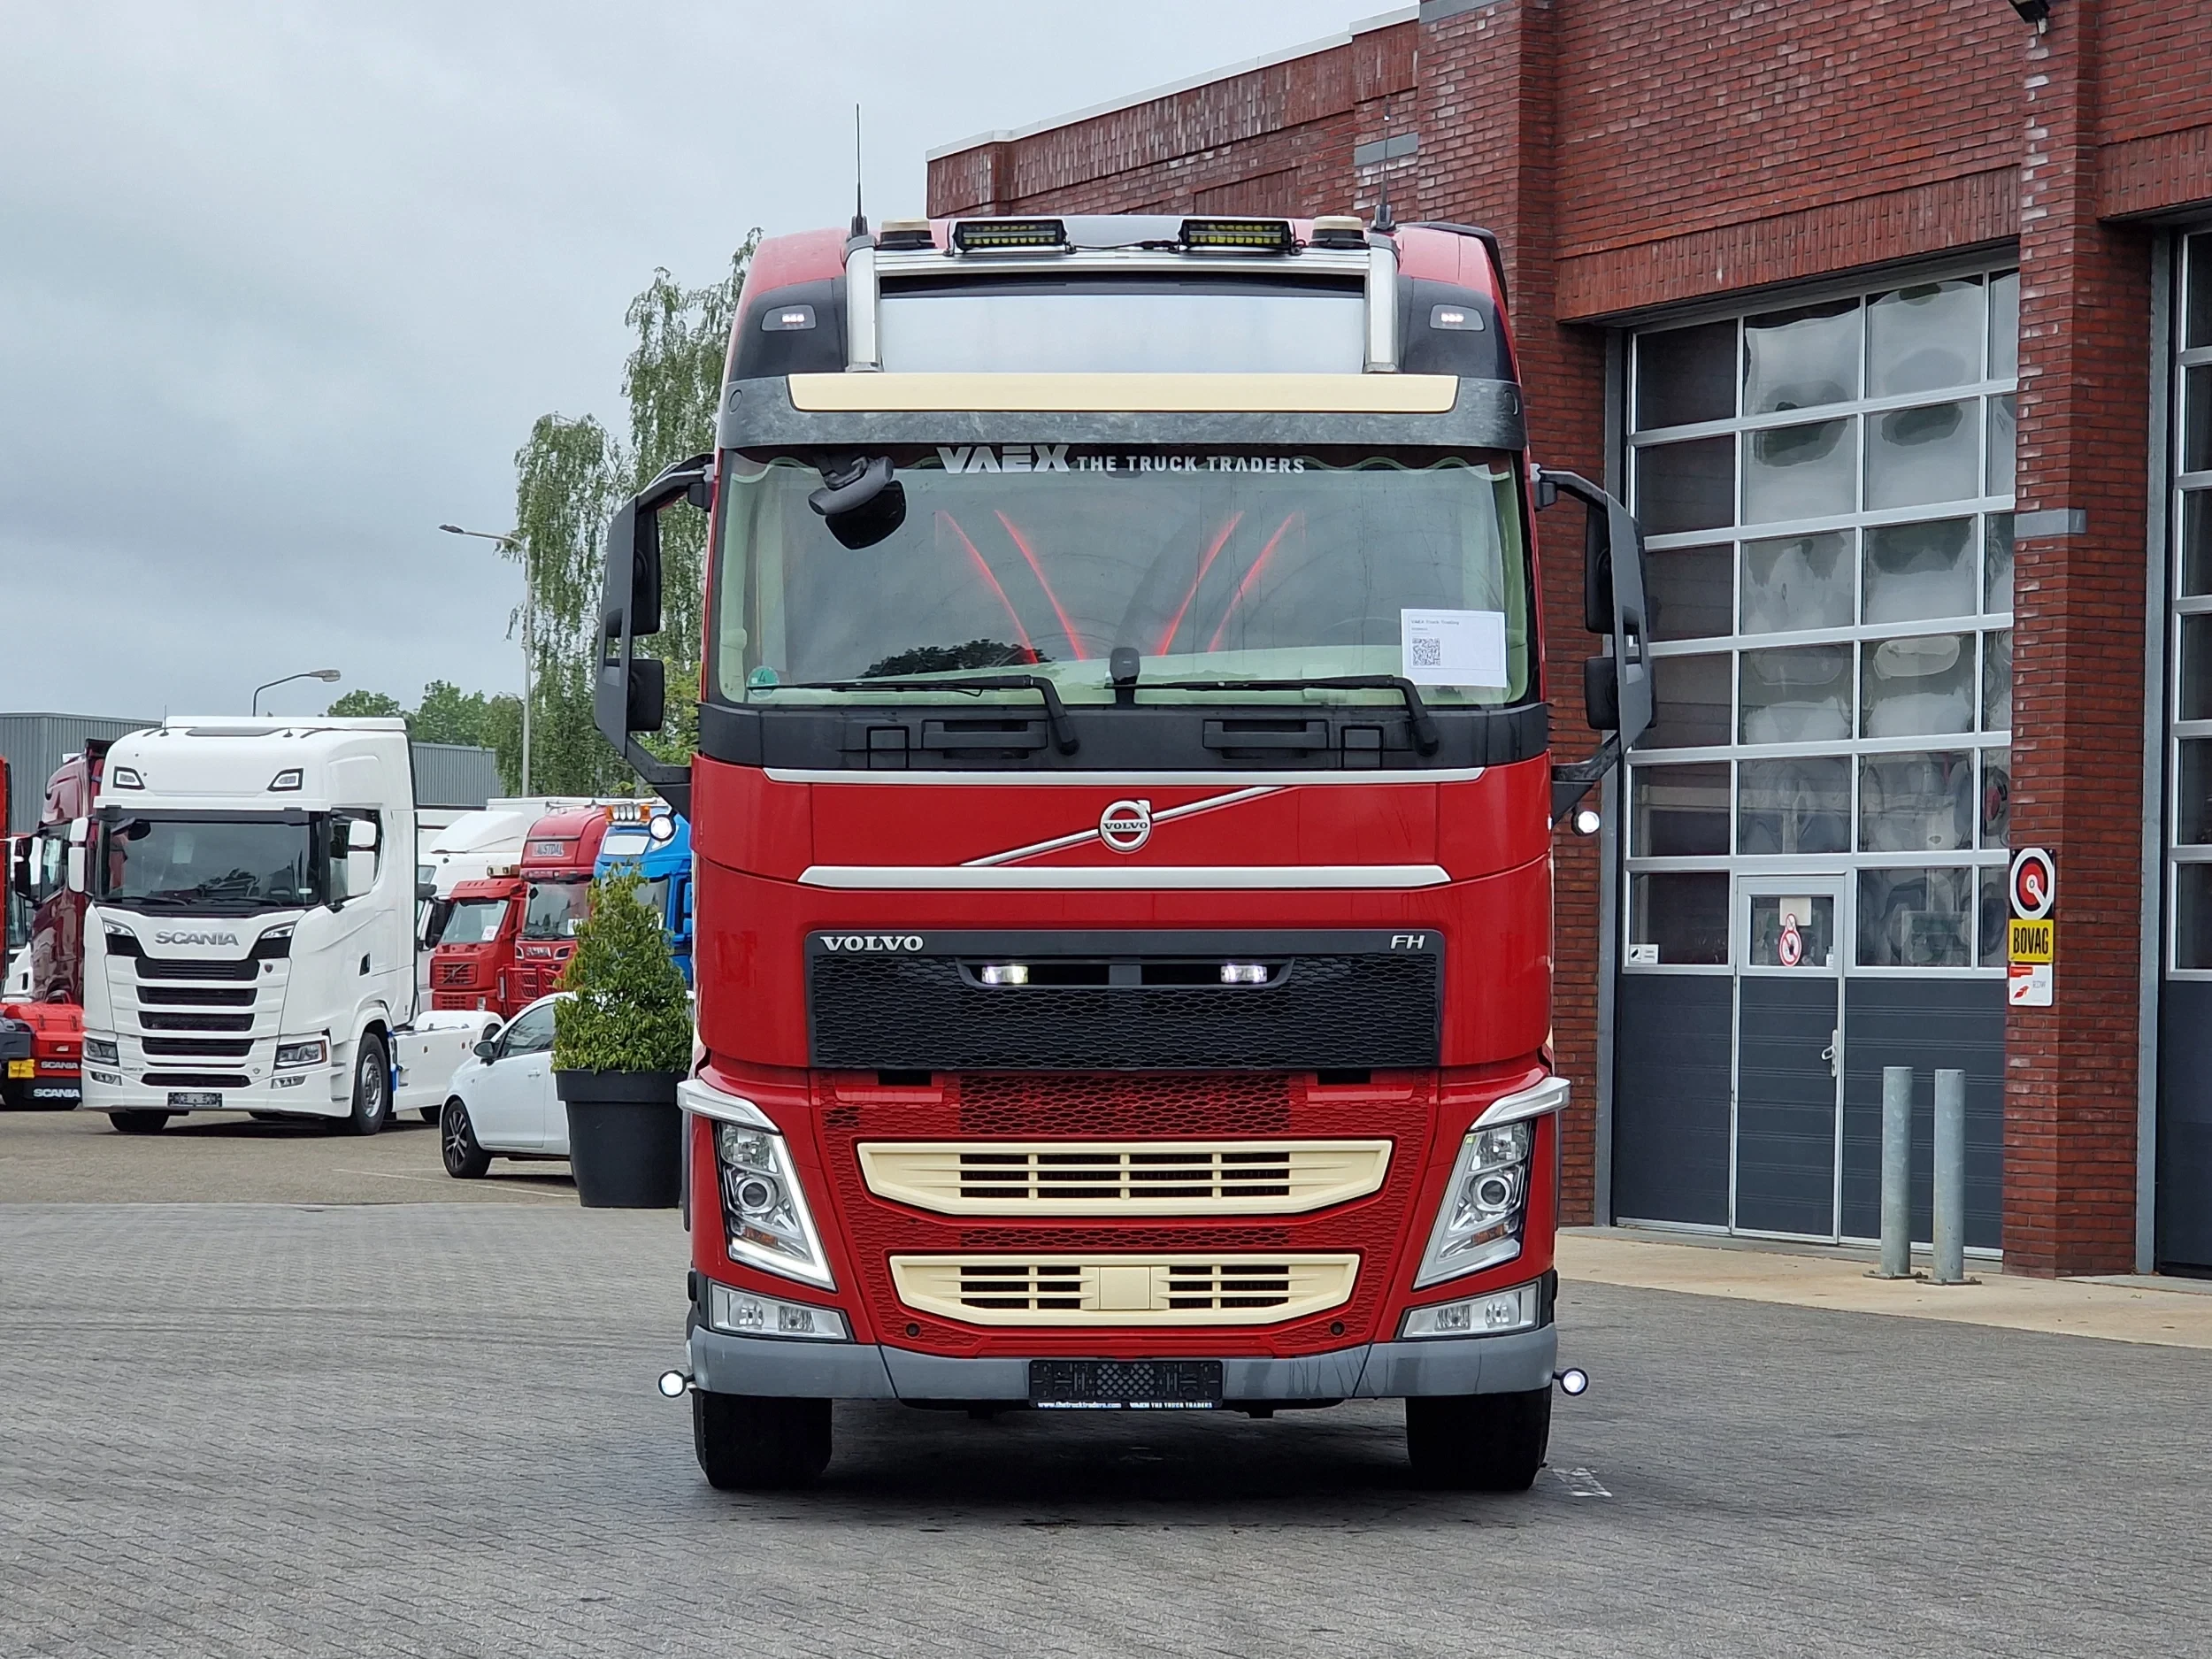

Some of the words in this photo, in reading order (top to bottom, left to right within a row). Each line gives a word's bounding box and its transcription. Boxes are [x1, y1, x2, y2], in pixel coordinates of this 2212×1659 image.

[936, 444, 1070, 474] VAEX
[1077, 456, 1117, 472] THE
[1125, 455, 1197, 472] TRUCK
[1206, 456, 1305, 474] TRADERS
[1102, 821, 1148, 830] VOLVO
[154, 931, 240, 946] SCANIA
[819, 935, 924, 951] VOLVO
[1390, 935, 1425, 949] FH
[2013, 926, 2049, 955] BOVAG
[33, 1088, 81, 1098] SCANIA
